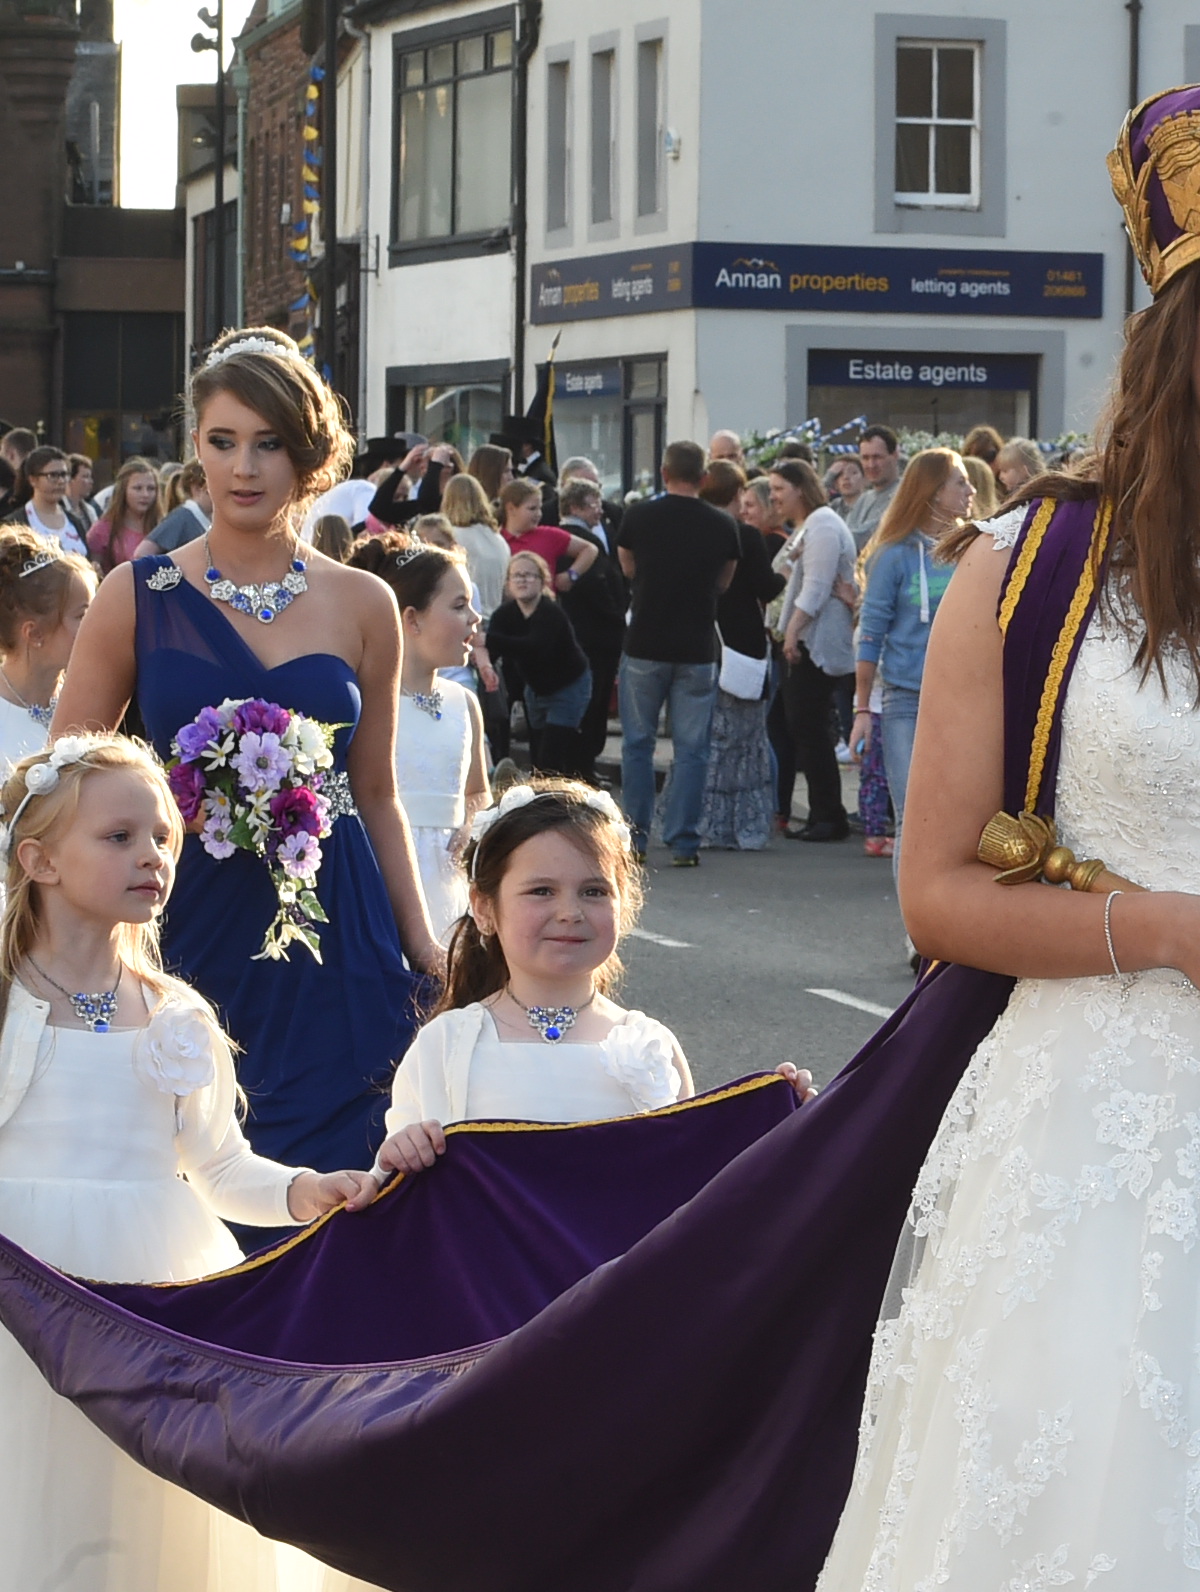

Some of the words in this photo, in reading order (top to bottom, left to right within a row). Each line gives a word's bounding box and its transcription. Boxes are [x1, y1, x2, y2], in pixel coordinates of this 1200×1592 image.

[538, 282, 562, 307] Annan
[563, 277, 599, 308] properties
[612, 277, 630, 302] letting
[631, 275, 653, 301] agents
[715, 267, 782, 289] Annan
[789, 272, 890, 294] properties
[911, 277, 956, 297] letting
[960, 280, 1011, 298] agents
[566, 372, 583, 392] Estate
[584, 373, 603, 395] agents
[849, 359, 913, 380] Estate
[918, 362, 987, 386] agents
